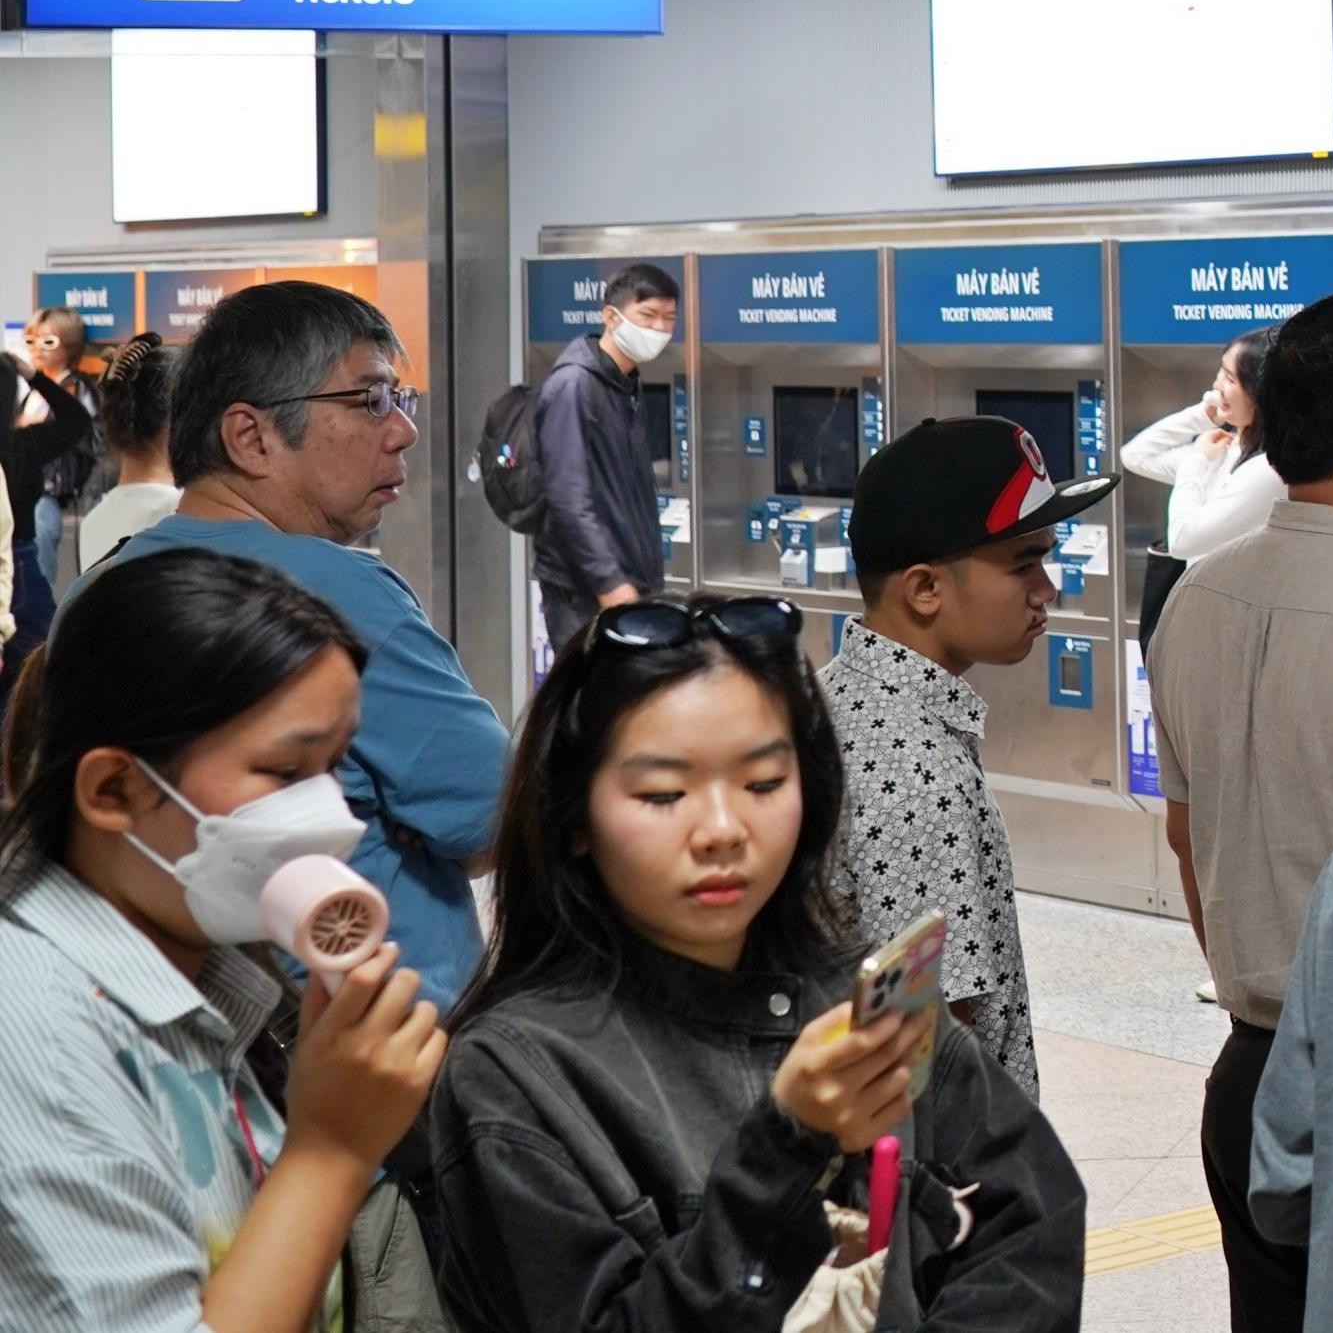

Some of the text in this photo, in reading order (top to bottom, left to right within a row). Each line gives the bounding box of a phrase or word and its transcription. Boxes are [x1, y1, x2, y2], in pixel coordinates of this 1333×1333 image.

[752, 273, 782, 299] MÁY
[783, 272, 810, 299] BÁN
[956, 267, 1040, 296] MÁY BÁN VÉ
[1190, 260, 1289, 292] MÁY BÁN VÉ
[738, 308, 766, 324] TICKET
[799, 308, 837, 323] MACHINE
[940, 306, 1054, 322] TICKET VENDING MACHINE
[1173, 304, 1207, 321] TICKET
[1208, 303, 1252, 320] VENDING
